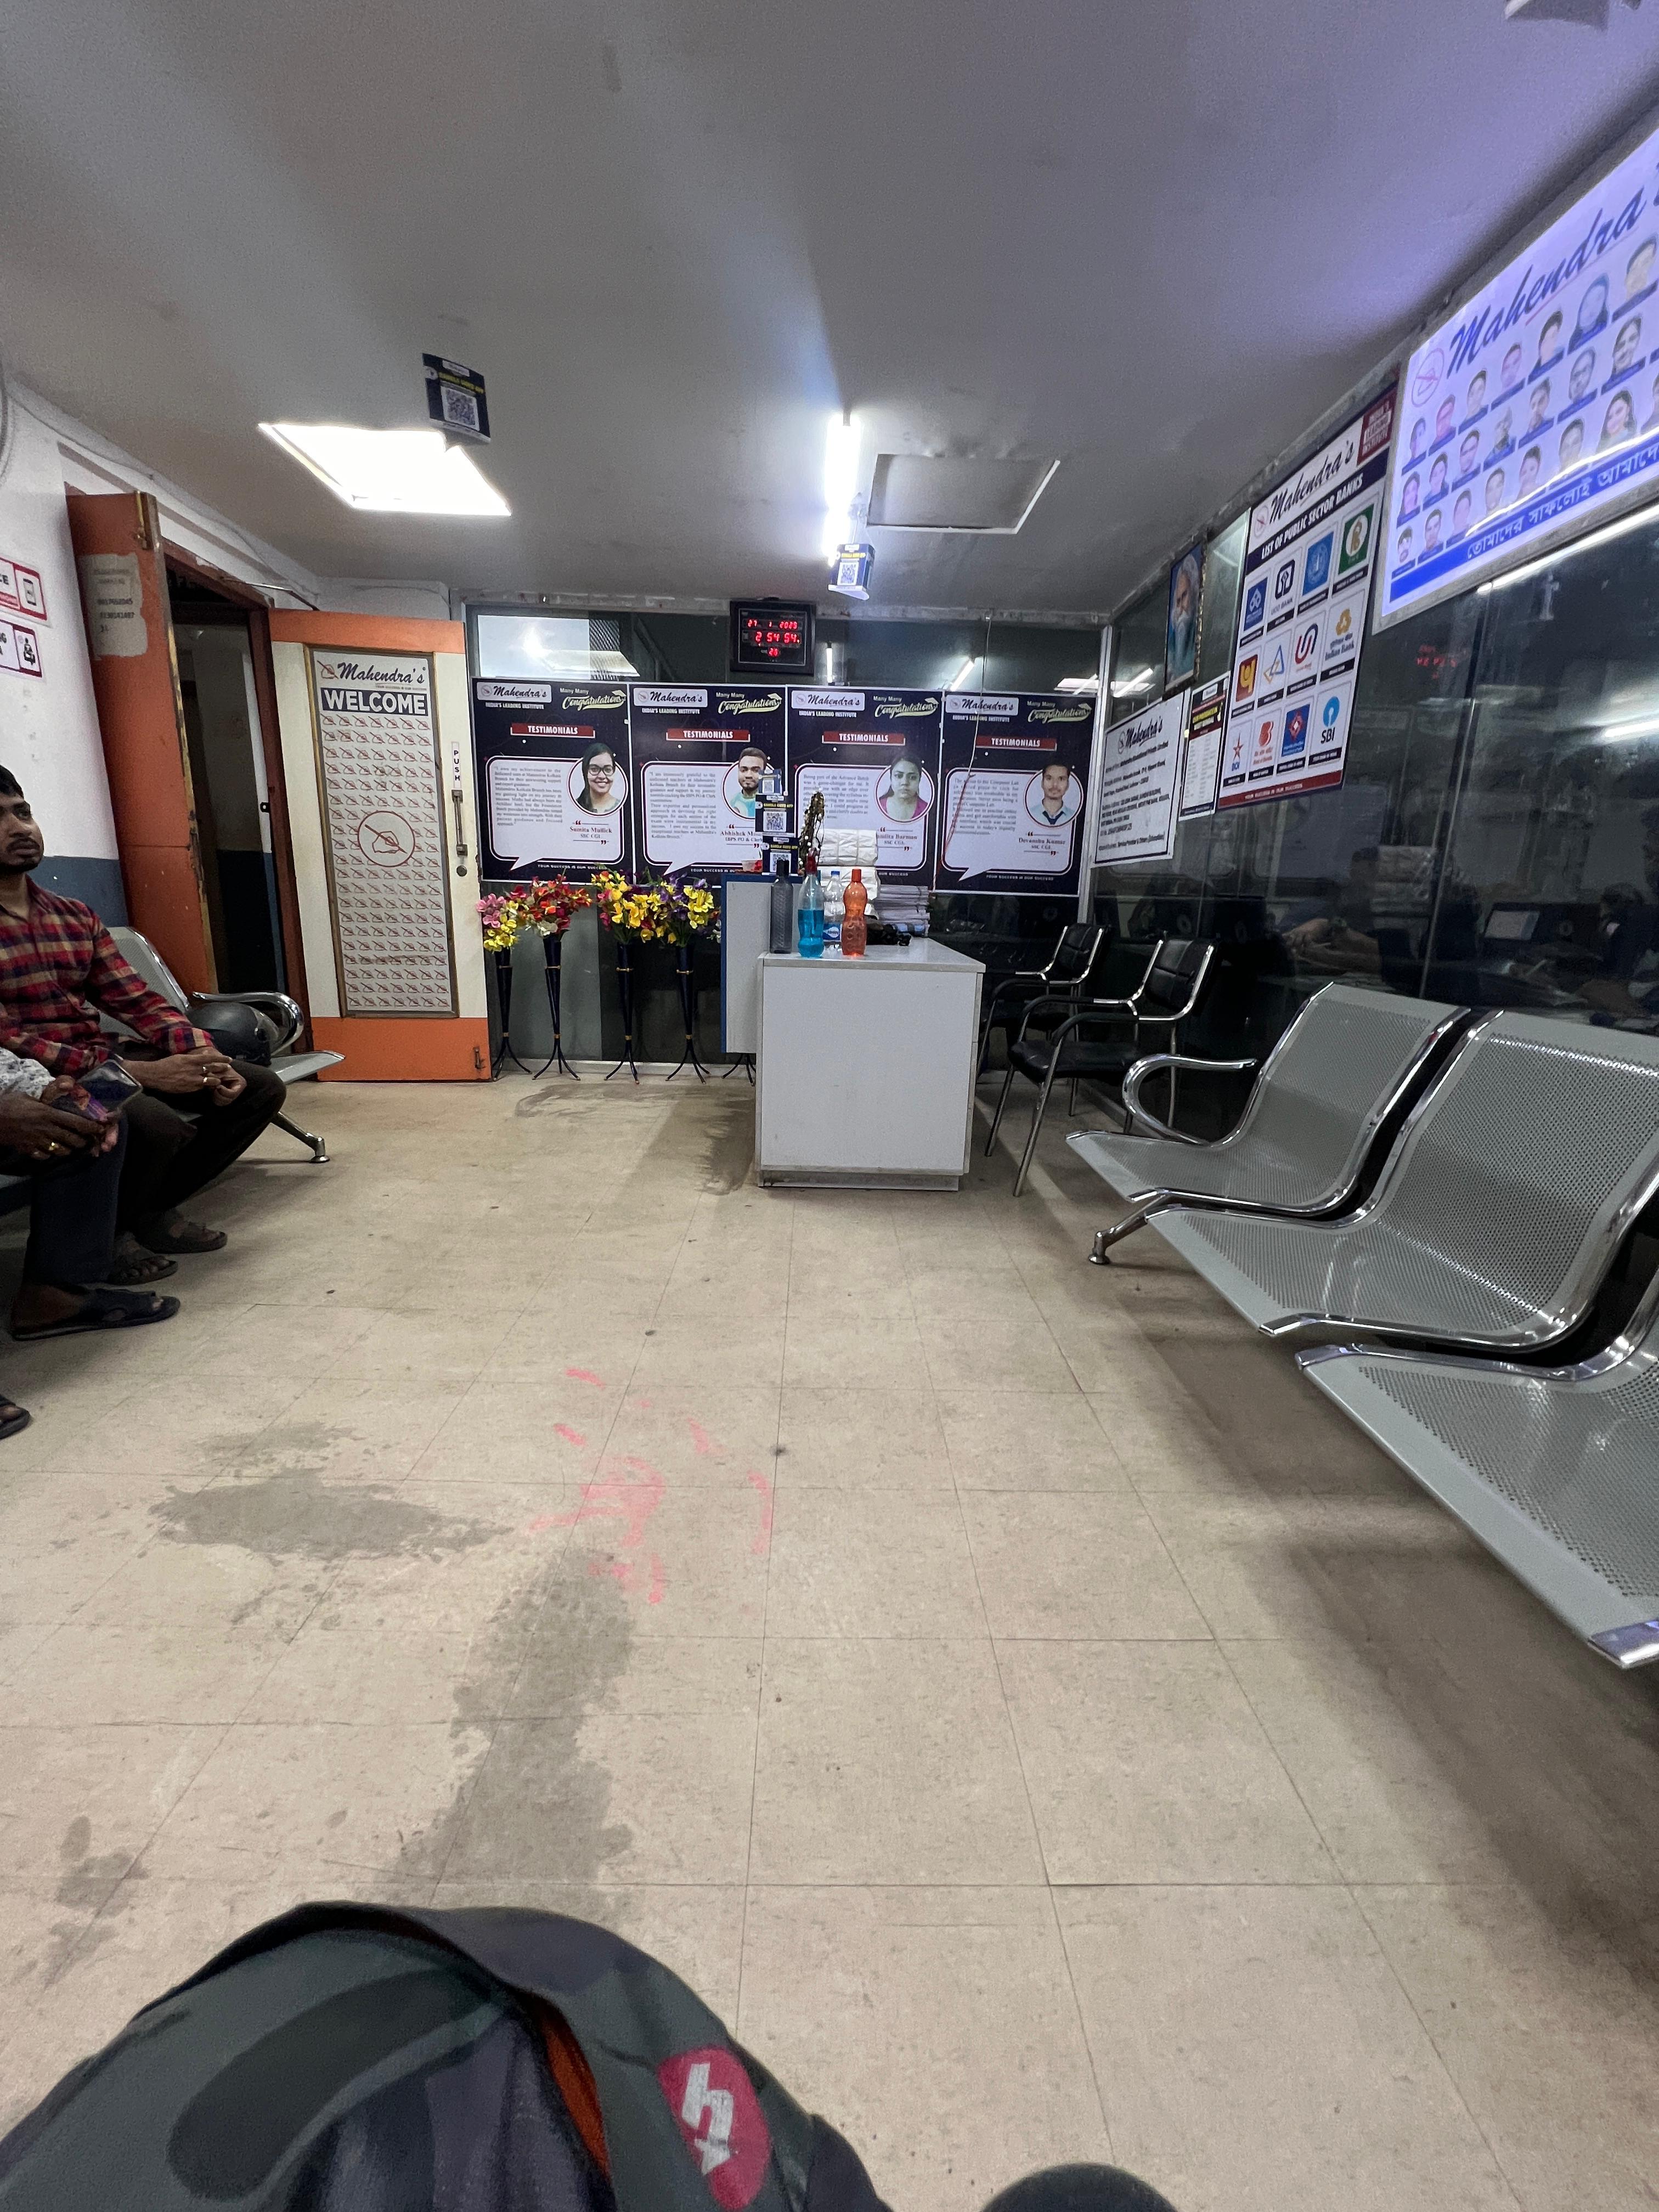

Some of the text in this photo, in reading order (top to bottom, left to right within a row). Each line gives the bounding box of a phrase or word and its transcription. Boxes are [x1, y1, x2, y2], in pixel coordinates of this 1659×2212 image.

[1447, 161, 1659, 380] Mahendra
[1596, 444, 1659, 487] আমাদে
[1269, 440, 1355, 524] Mahendra's
[1262, 473, 1363, 559] LIST OF PUBLIC SECTOR BANKS
[337, 662, 425, 684] Mahendra's
[493, 685, 548, 698] Mahendra's
[650, 691, 703, 702] Mahendra's
[324, 690, 426, 714] WELCOME
[562, 695, 624, 711] Congratulations
[718, 698, 778, 715] Congratulations
[808, 694, 860, 706] Mahendra's
[962, 698, 1014, 712] Mahendra's
[874, 703, 936, 719] Congratulations
[1027, 708, 1088, 724] Congratulations
[527, 726, 578, 735] TESTIMONIALS
[683, 730, 733, 738] TESTIMONIALS
[839, 733, 888, 742] TESTIMONIALS
[1321, 727, 1335, 744] SBI
[991, 738, 1040, 747] TESTIMONIALS
